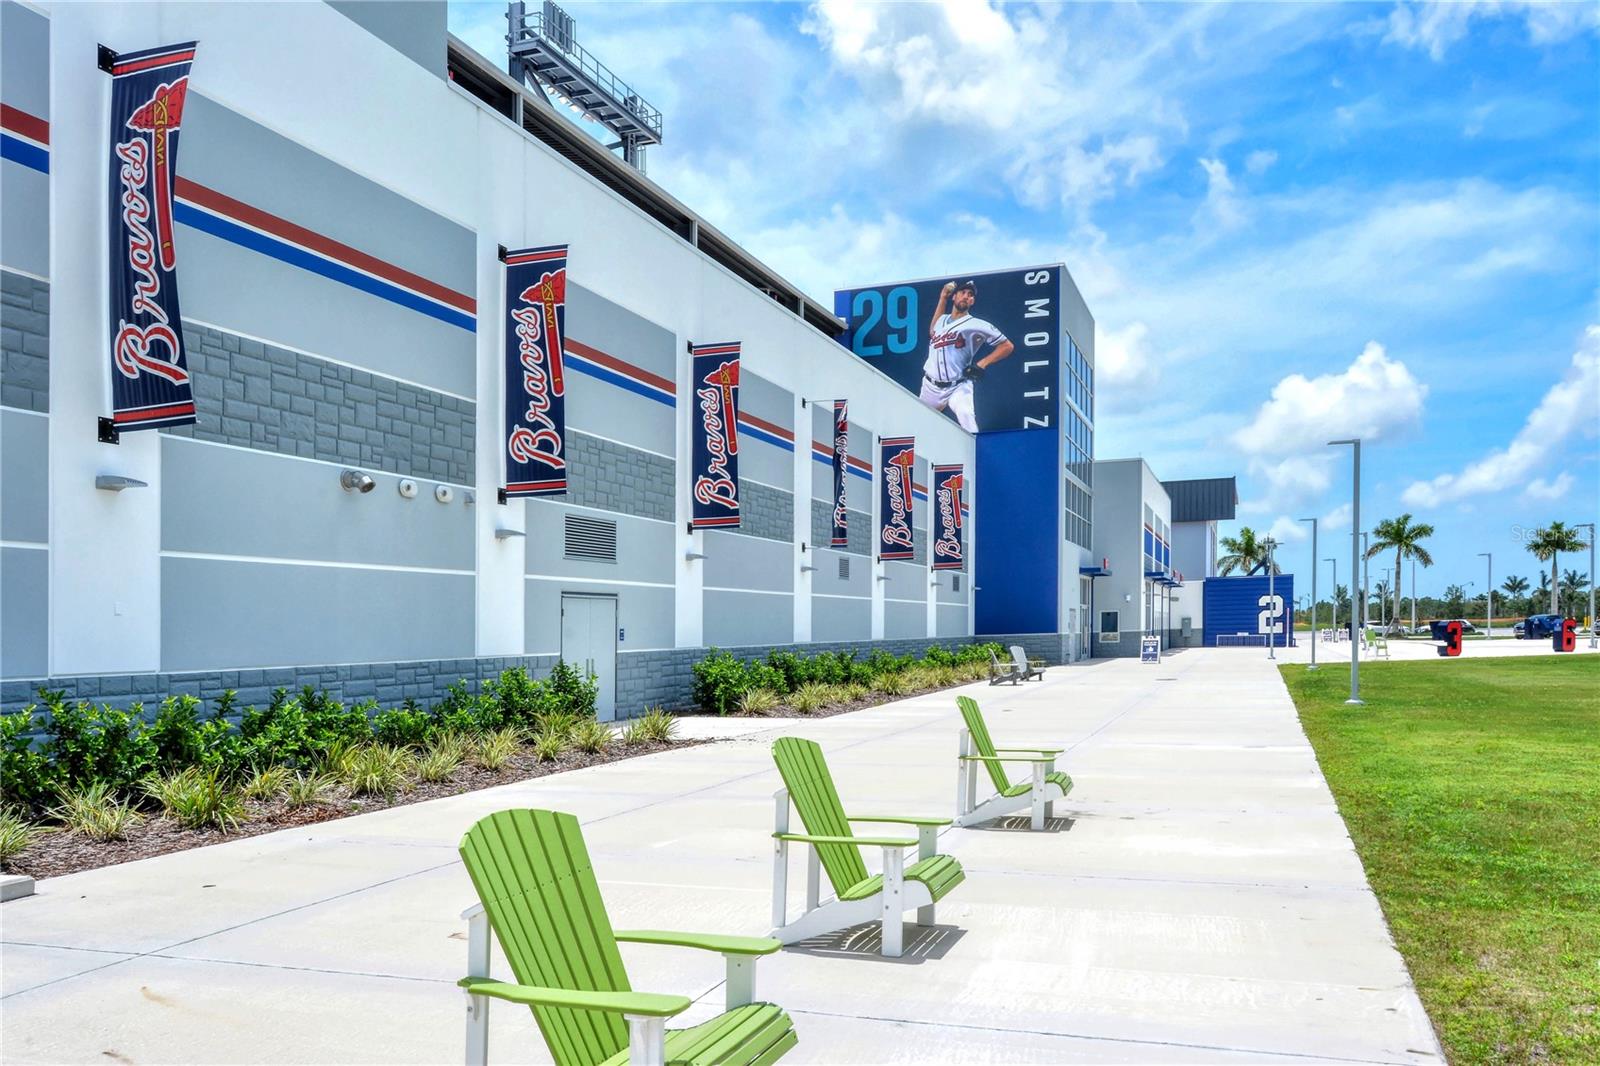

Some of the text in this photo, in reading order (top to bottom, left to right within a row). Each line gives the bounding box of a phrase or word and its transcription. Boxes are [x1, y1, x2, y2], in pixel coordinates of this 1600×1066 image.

[114, 136, 189, 386] Braves
[852, 287, 919, 357] 29
[1023, 270, 1050, 429] SMOLTZ
[508, 307, 565, 470] Braves
[694, 388, 738, 510] Braves
[882, 466, 913, 547] Braves
[935, 490, 962, 559] Braves
[1258, 595, 1284, 634] 2
[1446, 620, 1463, 656] 3
[1561, 618, 1577, 652] 6
